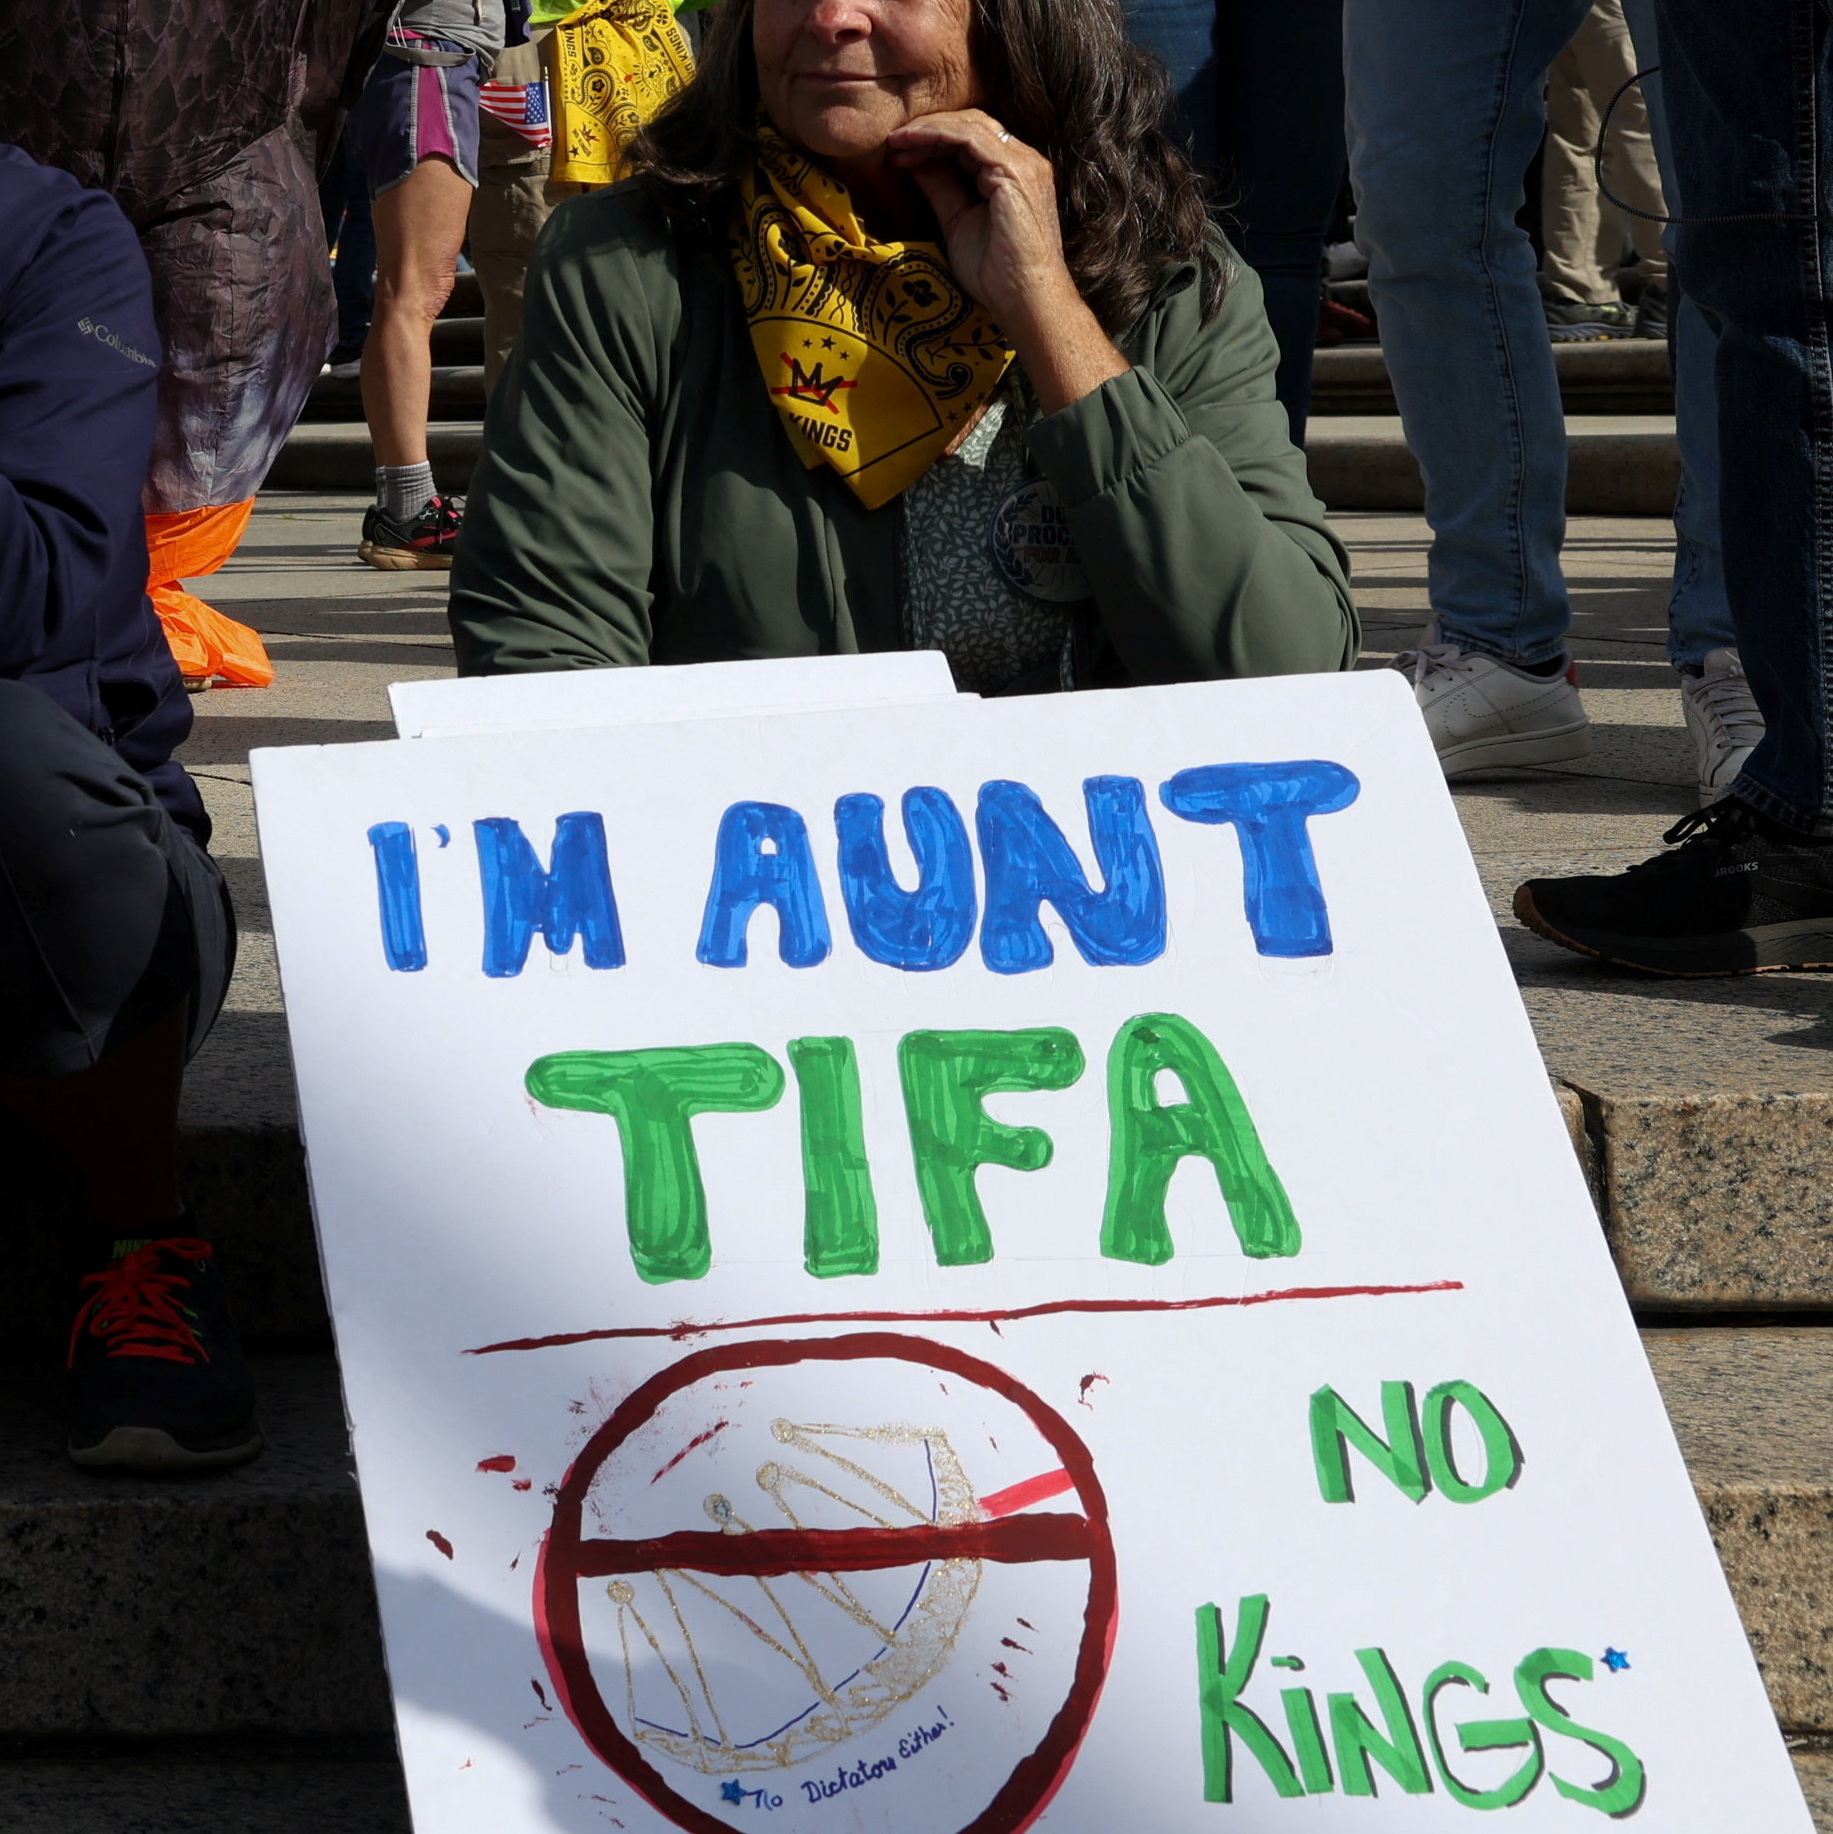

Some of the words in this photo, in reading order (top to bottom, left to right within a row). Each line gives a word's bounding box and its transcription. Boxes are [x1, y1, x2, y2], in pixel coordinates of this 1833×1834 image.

[666, 27, 690, 62] KINGS
[93, 323, 156, 368] Columbia
[1013, 525, 1075, 545] PROC
[1041, 505, 1067, 524] DU
[367, 808, 626, 980] I'M
[696, 757, 1361, 978] AUNT
[523, 1009, 1303, 1286] TIFA
[1307, 1376, 1525, 1510] NO
[800, 1755, 898, 1804] Dictators
